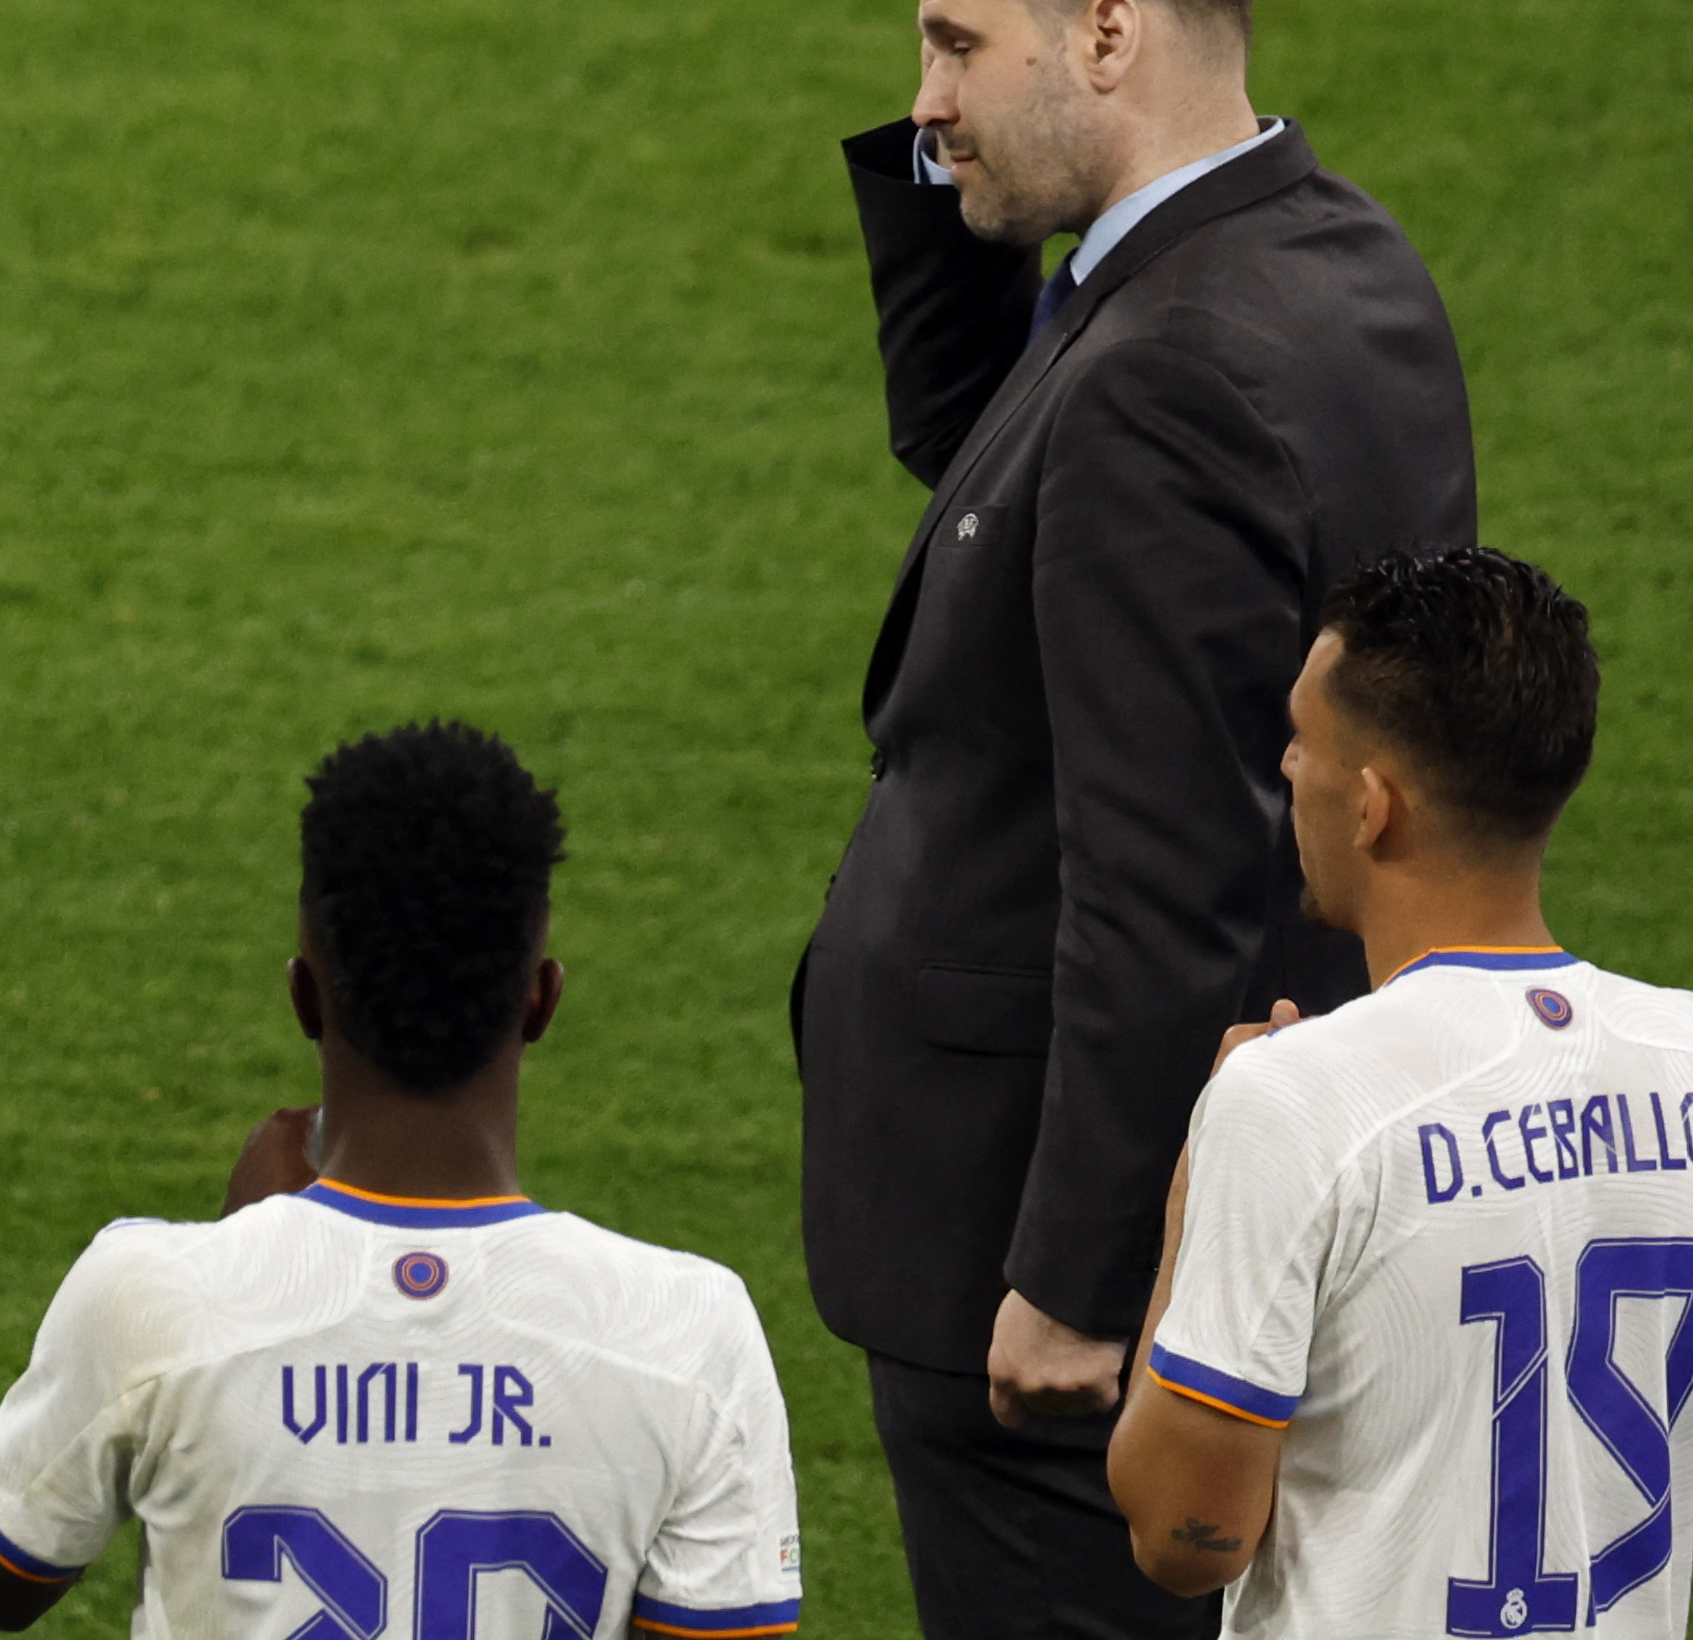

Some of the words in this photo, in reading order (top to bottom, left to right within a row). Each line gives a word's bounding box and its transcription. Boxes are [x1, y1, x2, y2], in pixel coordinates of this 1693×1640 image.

[282, 1362, 418, 1444] VINI
[448, 1364, 552, 1447] JR.
[1446, 1237, 1693, 1639] 19
